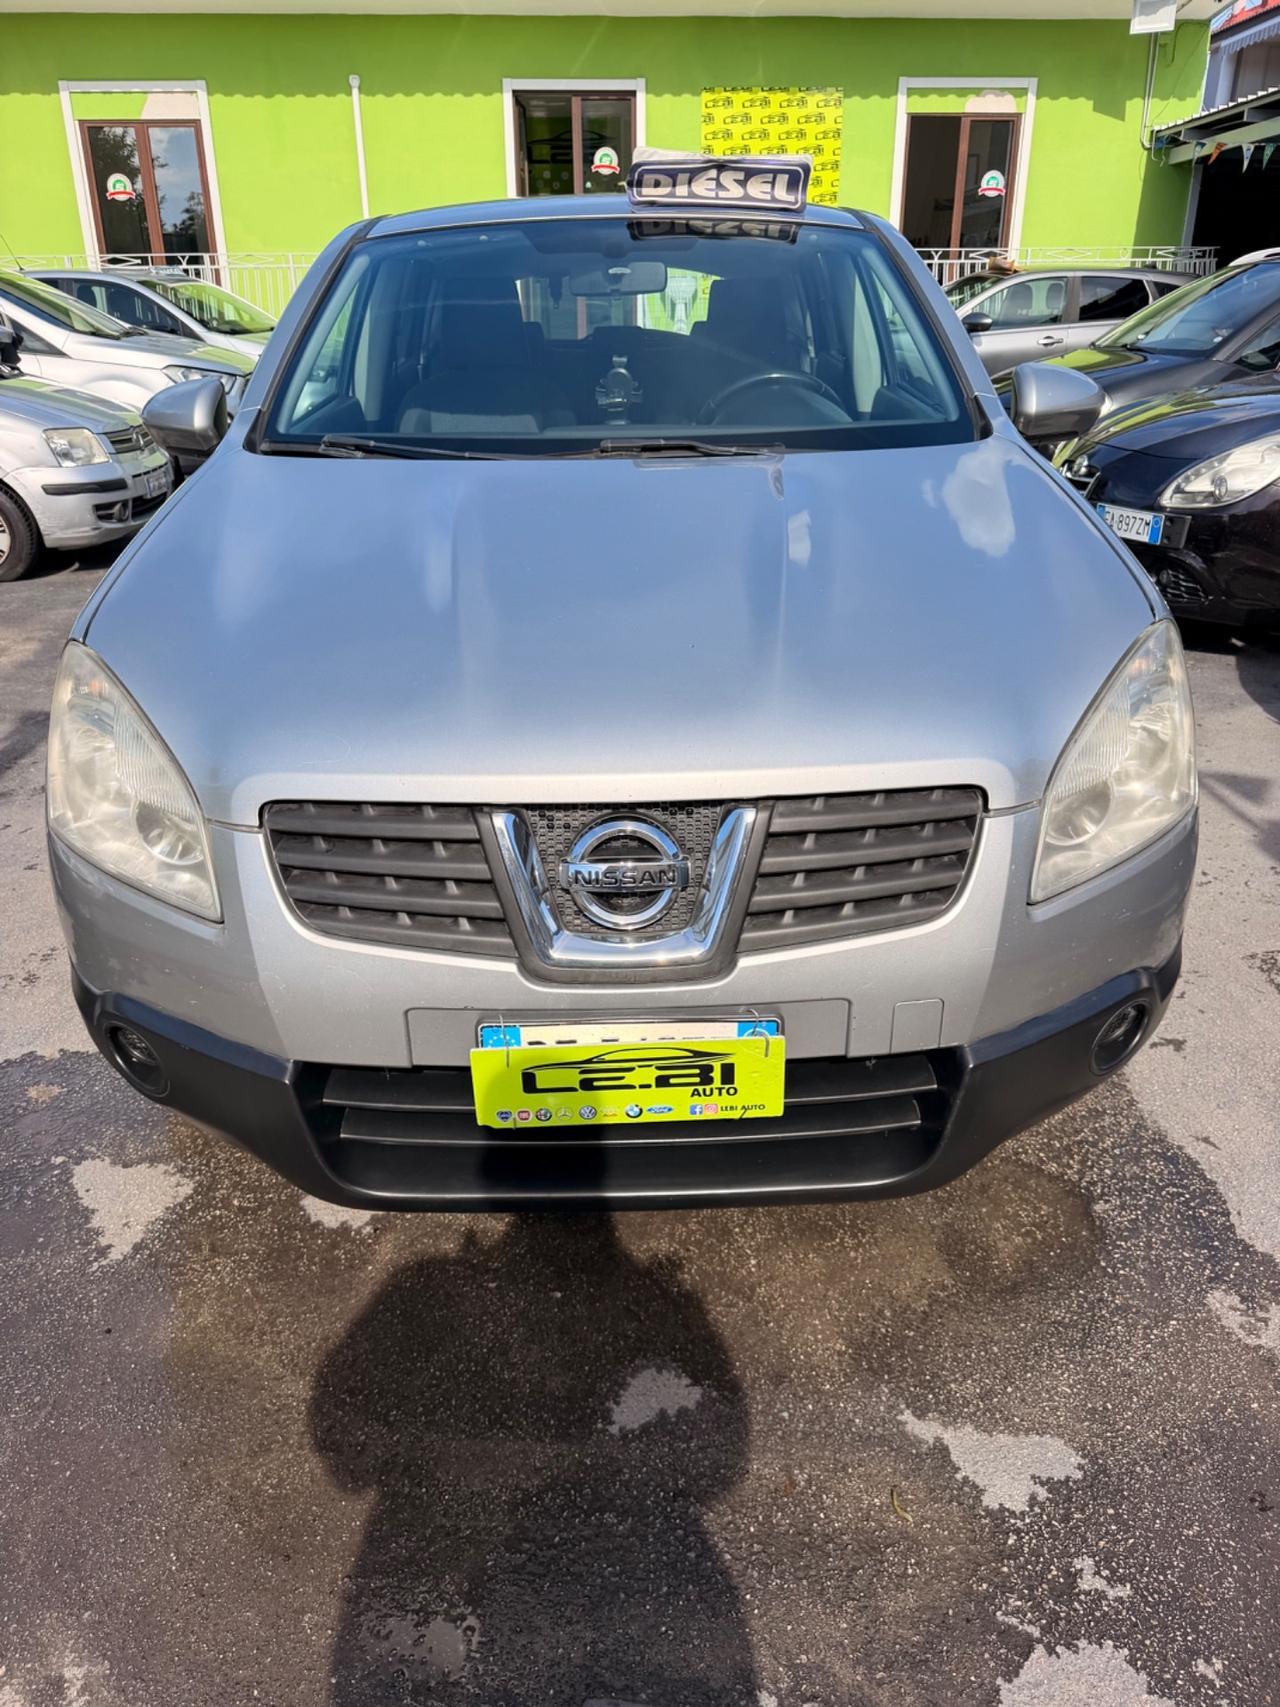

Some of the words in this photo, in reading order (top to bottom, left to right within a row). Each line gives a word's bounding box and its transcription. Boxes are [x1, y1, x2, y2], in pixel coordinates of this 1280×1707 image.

[641, 168, 798, 203] DIESEL
[573, 868, 677, 888] NISSAN
[690, 1086, 738, 1098] AUTO
